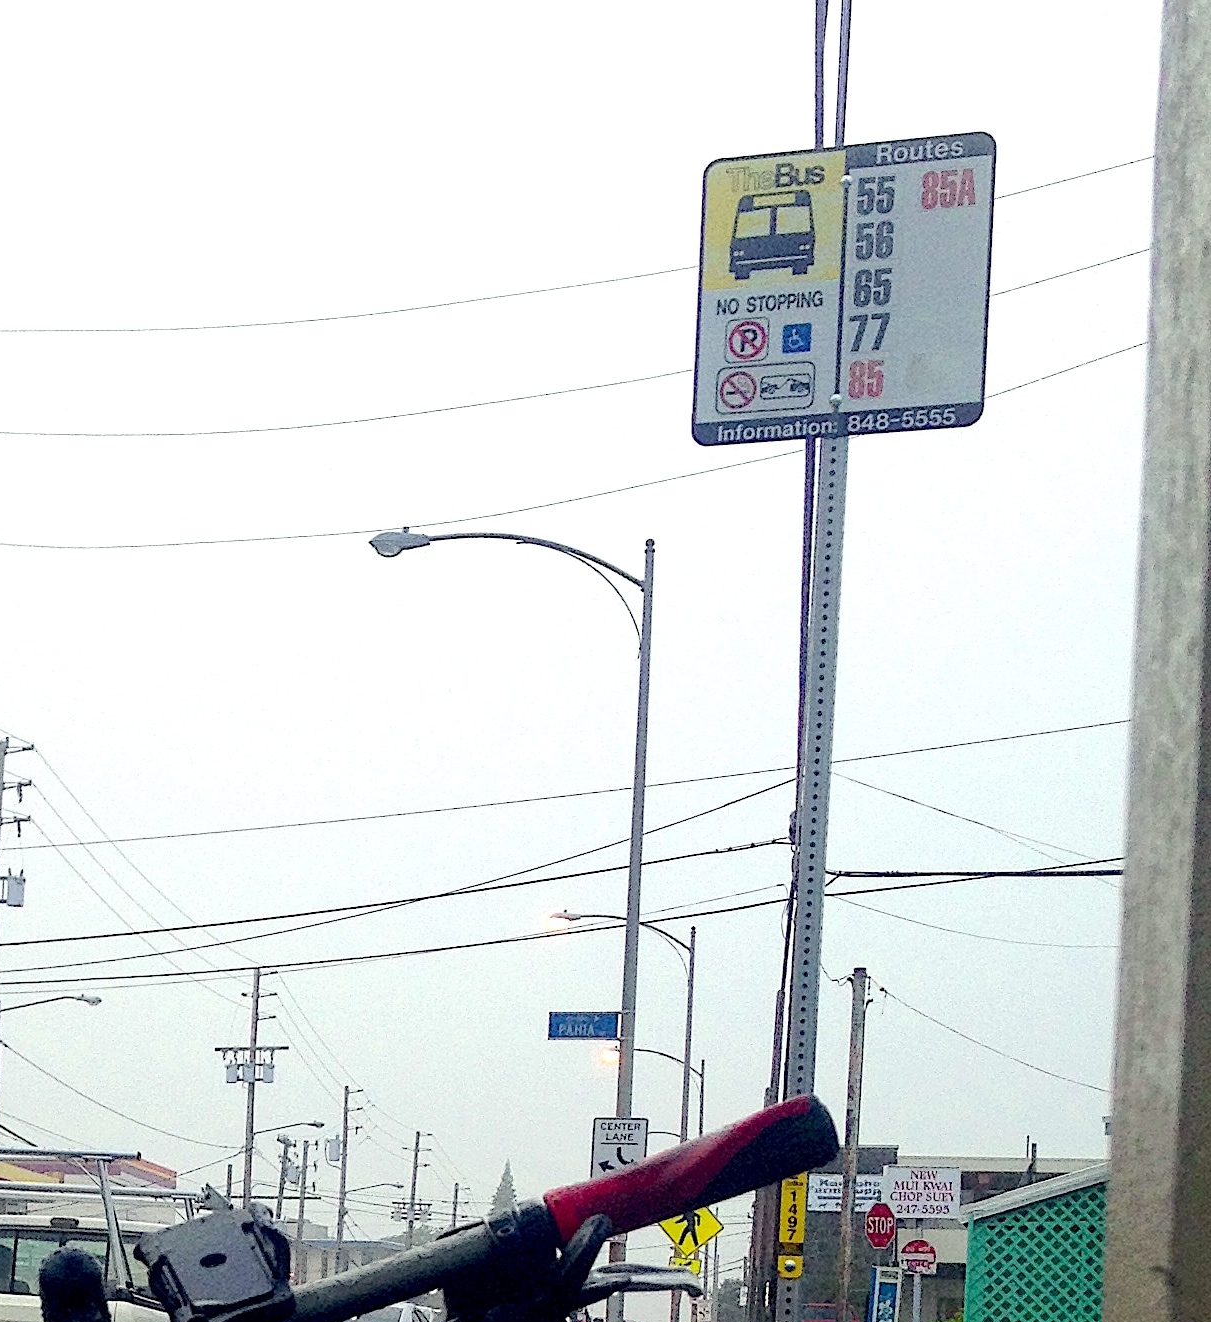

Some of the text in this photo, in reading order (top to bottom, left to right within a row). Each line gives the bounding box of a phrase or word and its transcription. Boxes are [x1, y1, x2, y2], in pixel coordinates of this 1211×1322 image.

[875, 139, 964, 166] Routes
[856, 176, 896, 216] 55
[921, 169, 977, 211] 85A
[854, 221, 894, 261] 56
[852, 268, 893, 308] 65
[716, 291, 824, 315] NO STOPPING
[848, 312, 891, 352] 77
[847, 360, 885, 400] 85
[847, 407, 956, 433] 848-5555
[600, 1122, 641, 1131] CENTER
[605, 1133, 634, 1141] LANE
[894, 1180, 953, 1191] MUI KWAI
[910, 1169, 938, 1181] NEW
[890, 1191, 923, 1202] CHOP
[926, 1191, 954, 1202] SUEY
[786, 1190, 798, 1241] 1497
[868, 1216, 894, 1234] STOP
